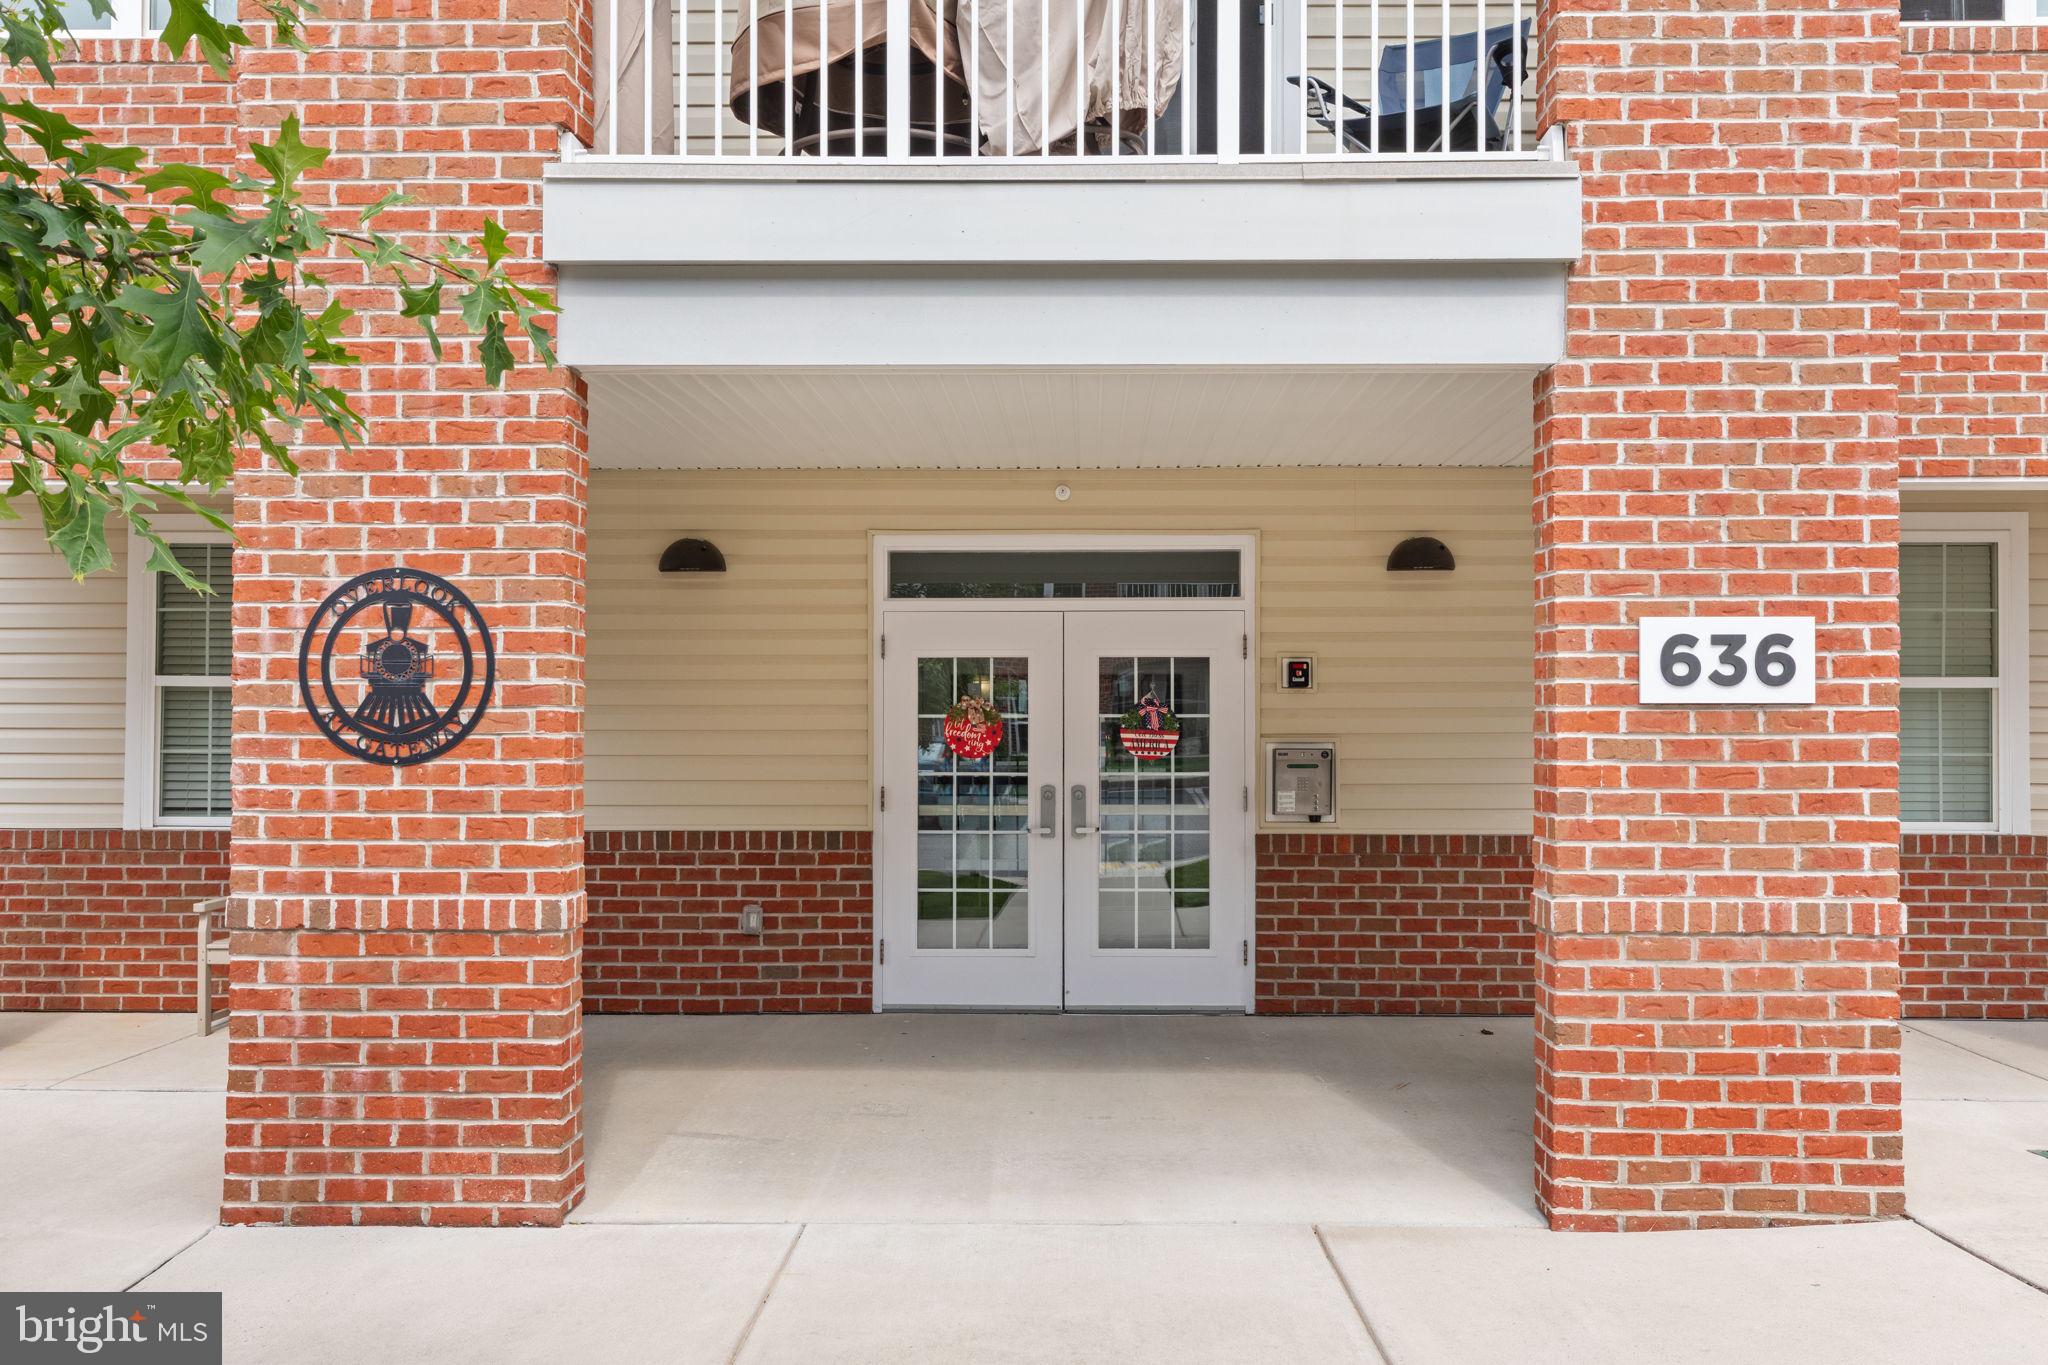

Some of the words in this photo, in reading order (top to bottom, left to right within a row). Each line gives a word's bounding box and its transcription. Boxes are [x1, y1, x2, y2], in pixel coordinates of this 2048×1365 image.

[331, 576, 461, 616] OVERLOOK
[1660, 633, 1796, 687] 636
[320, 711, 357, 734] AT
[356, 712, 464, 758] GATEWAY
[945, 722, 981, 742] freedom
[968, 739, 987, 753] ring
[1132, 738, 1169, 749] AMERICA
